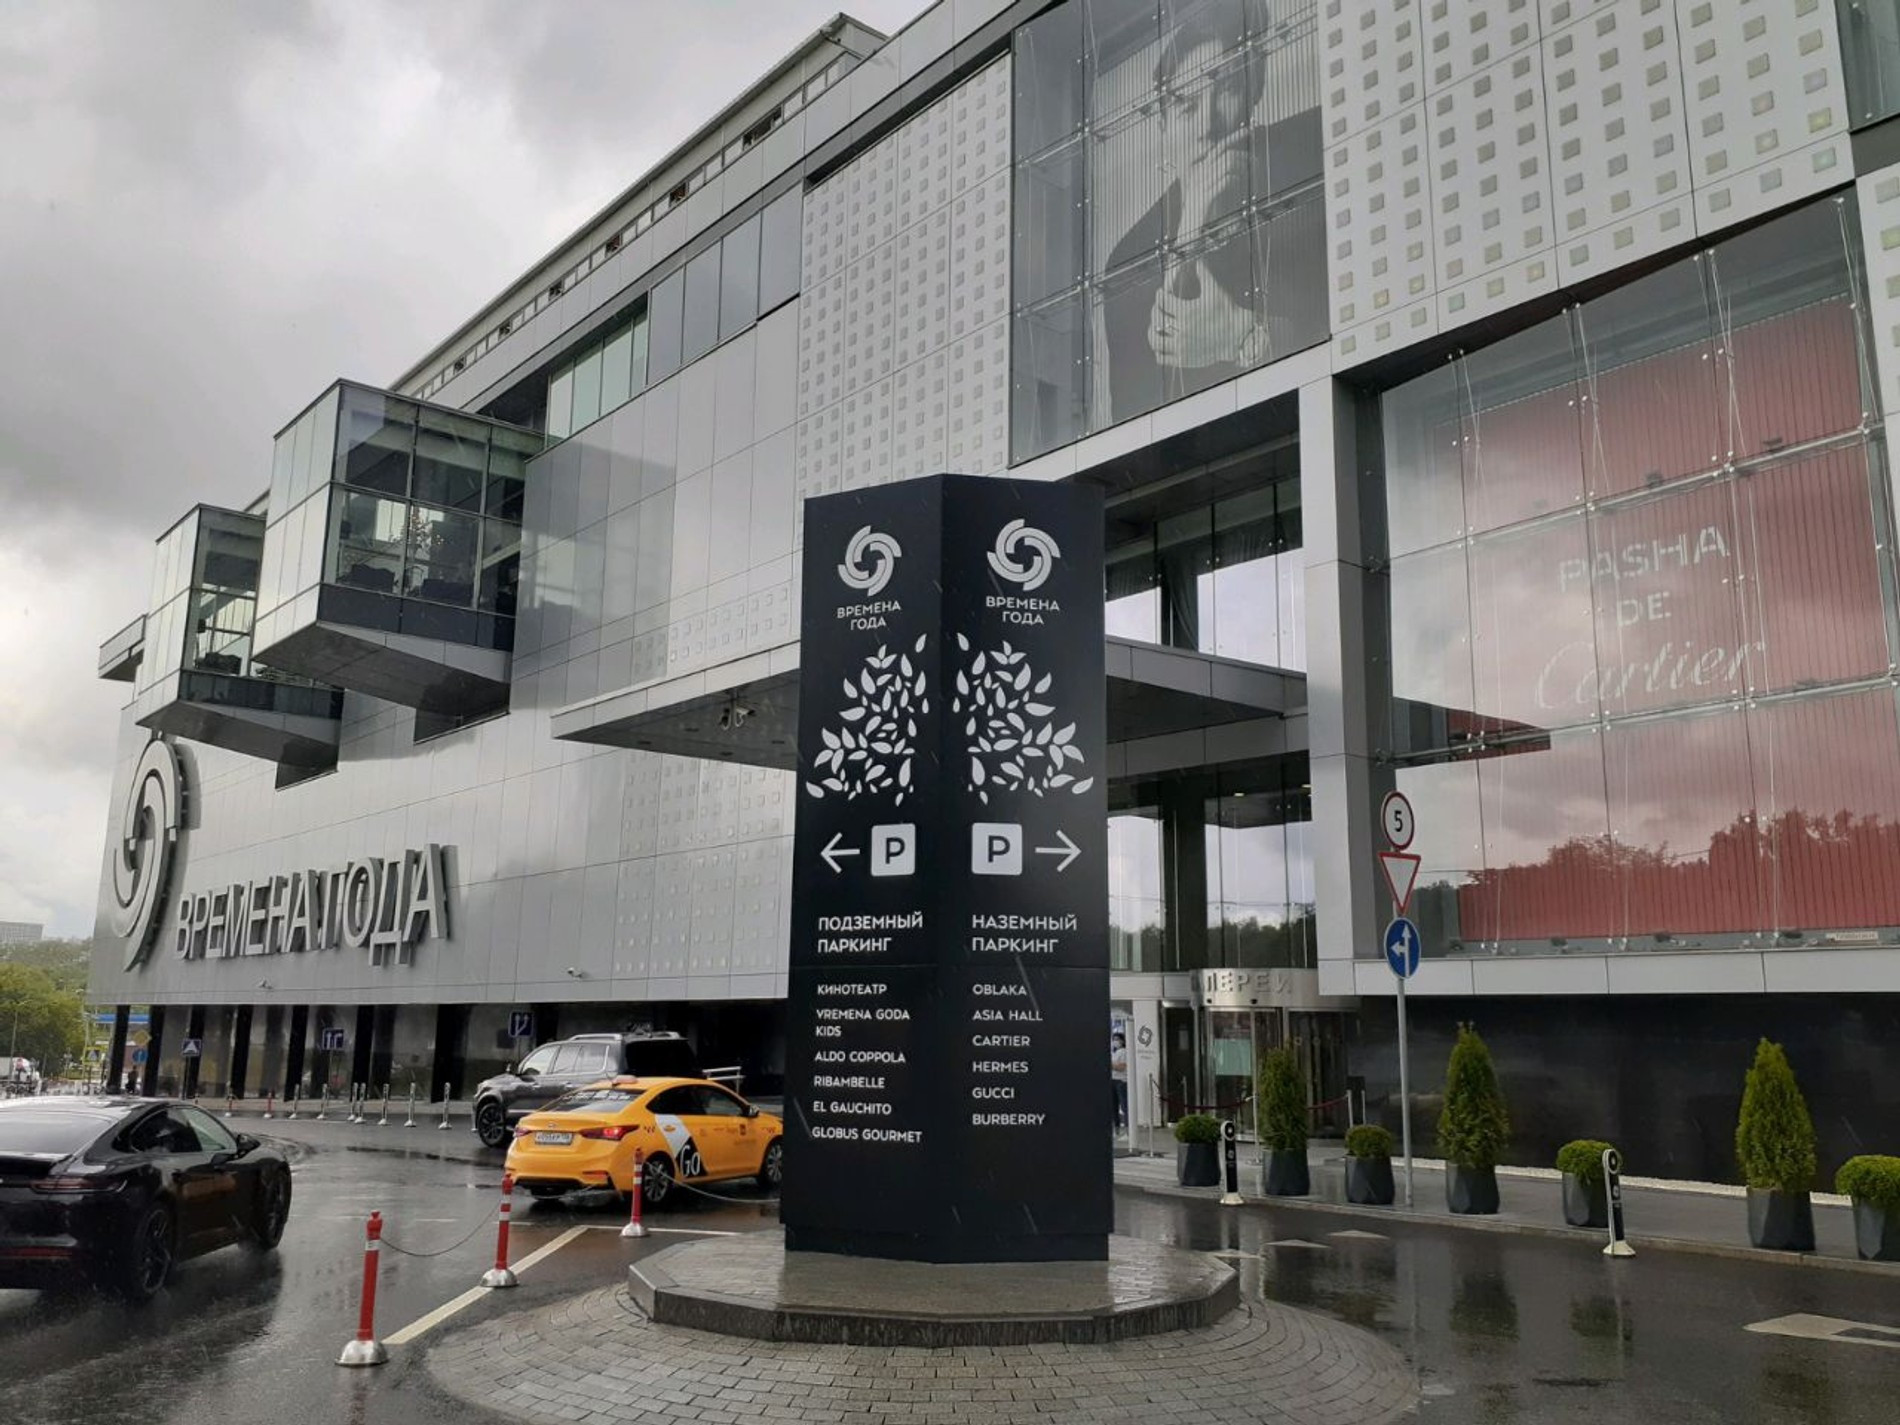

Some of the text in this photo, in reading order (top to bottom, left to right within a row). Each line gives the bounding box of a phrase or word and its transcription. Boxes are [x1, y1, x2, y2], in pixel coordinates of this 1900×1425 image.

[1558, 525, 1730, 592] PASHA
[838, 601, 900, 619] ВРЕМЕНА
[986, 596, 1059, 611] ВРЕМЕНА
[1617, 591, 1671, 628] DE
[851, 617, 886, 630] ГОДА
[1003, 609, 1043, 624] ГОДА
[1536, 641, 1764, 709] Cartier
[1394, 810, 1403, 832] 5
[175, 843, 448, 967] ВРЕМЕНА ГОДА
[819, 911, 922, 931] ПОДЗЕМНЫЙ
[973, 914, 1076, 930] НАЗЕМНЫЙ
[818, 938, 891, 952] ПАРКИНГ
[973, 937, 1058, 952] ПАРКИНГ
[818, 984, 887, 995] КИНОТЕАТР
[973, 984, 1026, 995] OBLAKA
[817, 1009, 909, 1020] VREMENA GODA
[973, 1010, 1042, 1021] ASIA HALL
[816, 1026, 841, 1036] KIDS
[973, 1035, 1030, 1046] CARTIER
[815, 1051, 905, 1063] ALDO COPPOLA
[973, 1061, 1028, 1072] HERMES
[814, 1076, 884, 1088] RIBAMBELLE
[972, 1087, 1014, 1098] GUCCI
[814, 1101, 891, 1114] EL GAUCHITO
[973, 1114, 1044, 1125] BURBERRY
[812, 1127, 922, 1142] GLOBUS GOURMET
[680, 1145, 701, 1177] Go
